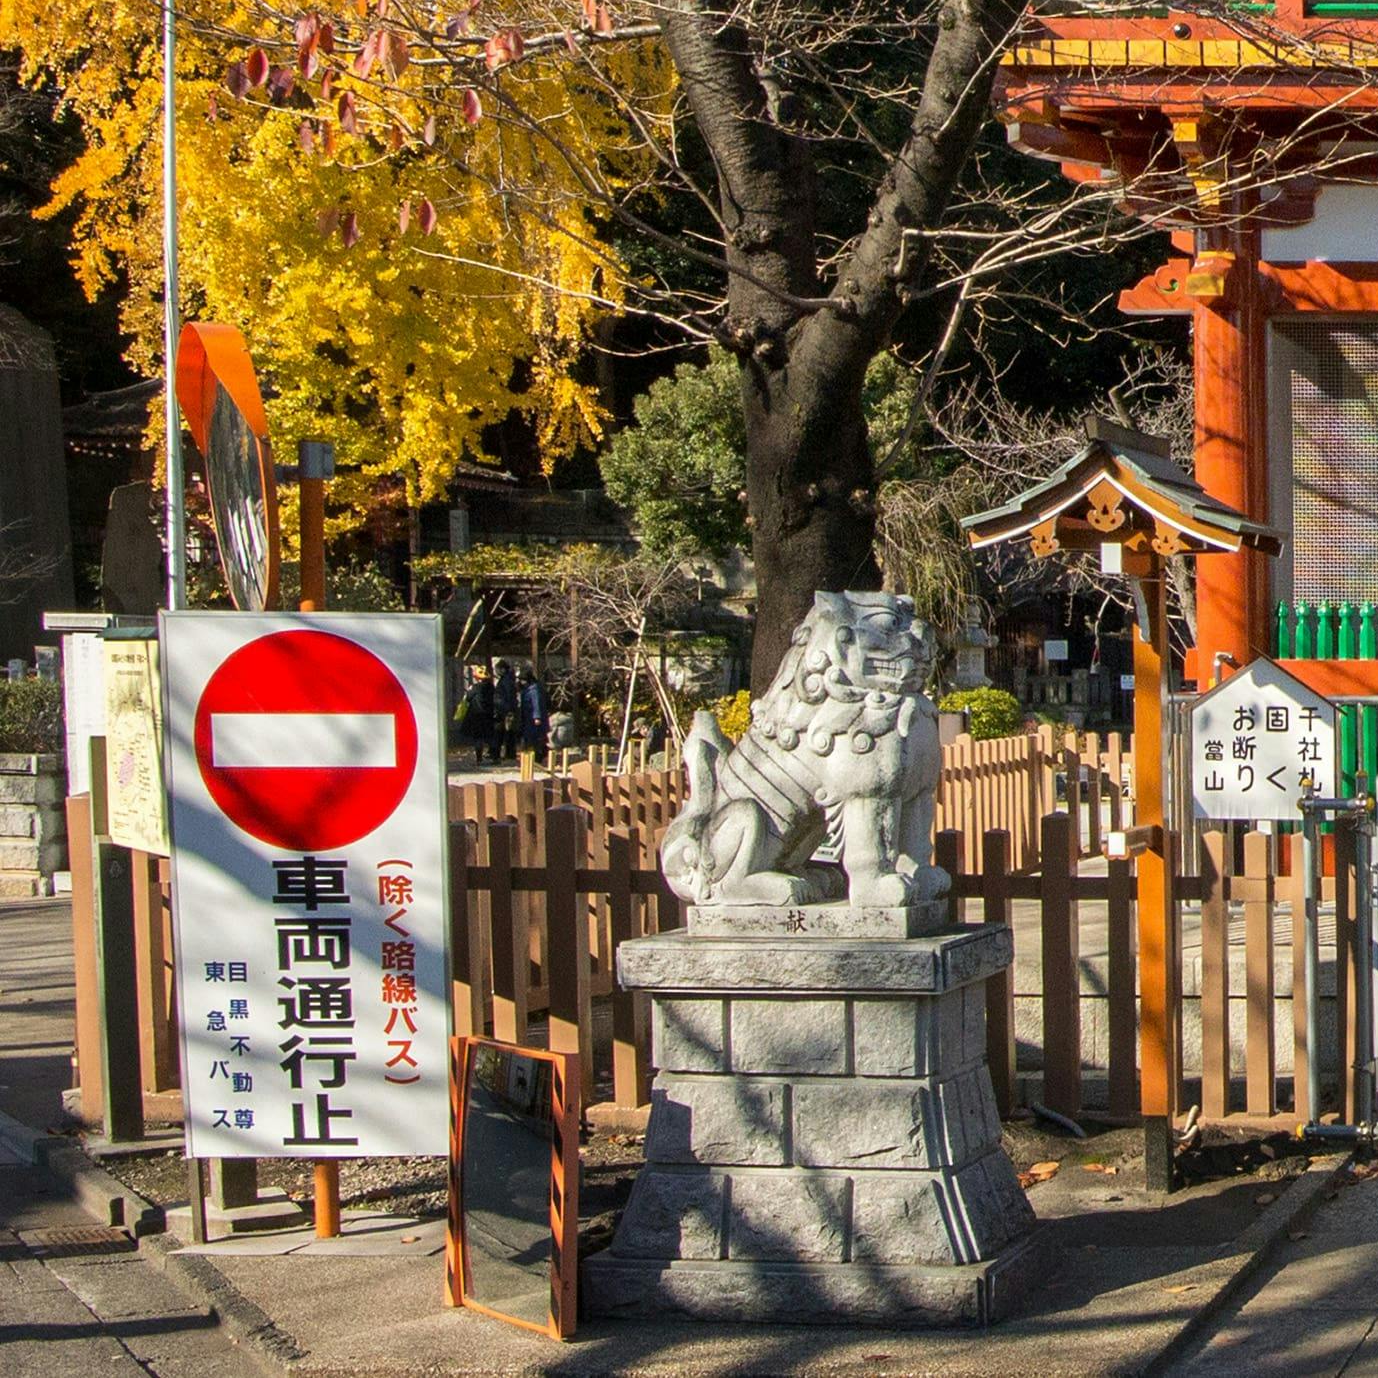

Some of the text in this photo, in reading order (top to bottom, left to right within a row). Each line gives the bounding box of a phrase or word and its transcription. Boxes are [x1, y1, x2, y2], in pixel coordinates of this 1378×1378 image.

[1204, 739, 1225, 792] 當山
[1232, 705, 1257, 793] お断り
[1265, 706, 1290, 793] 固く
[204, 961, 232, 1129] 東急バス
[228, 961, 255, 1130] 目黒不動尊
[271, 855, 359, 1147] 車両通行止
